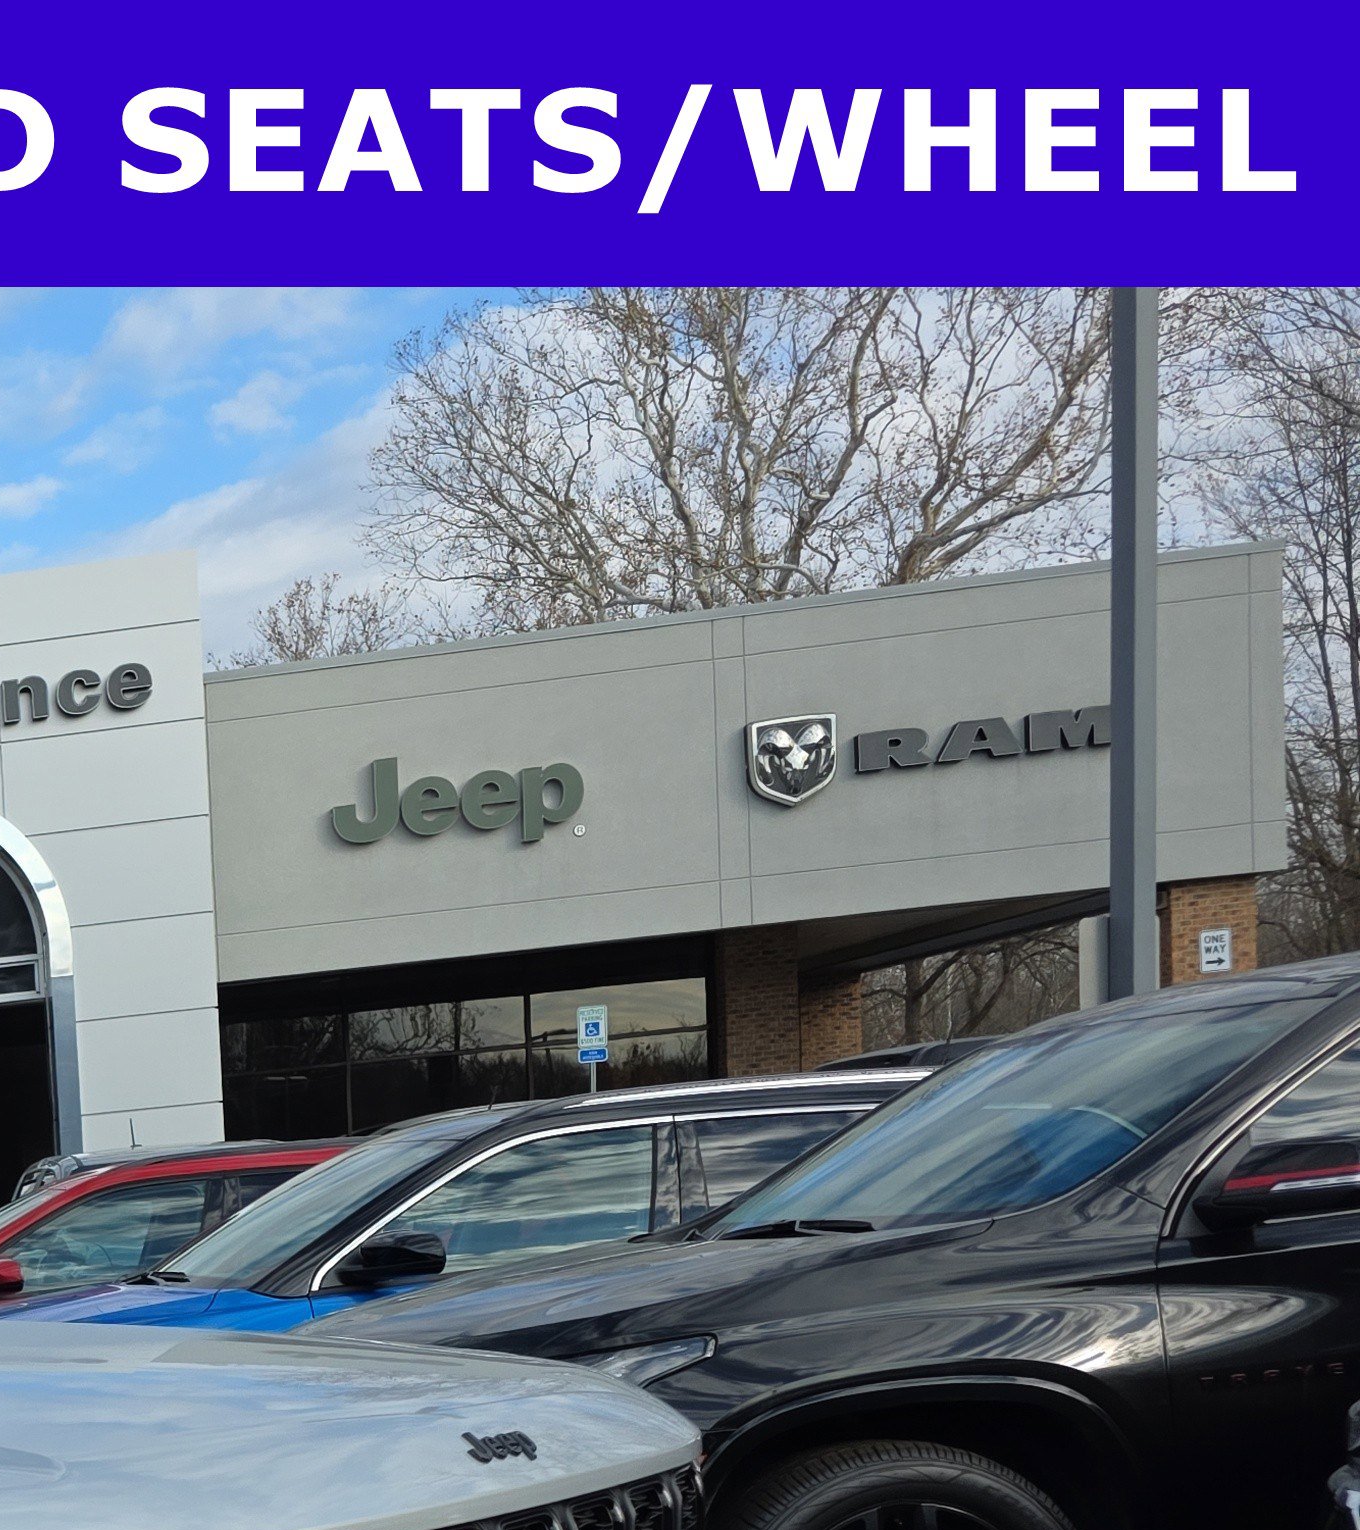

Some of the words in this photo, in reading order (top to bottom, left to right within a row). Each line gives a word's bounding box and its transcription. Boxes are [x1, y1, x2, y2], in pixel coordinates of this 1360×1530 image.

[853, 704, 1111, 775] RAM
[331, 756, 585, 844] Jeep
[1204, 934, 1226, 943] ONE
[1204, 944, 1227, 954] WAY
[461, 1431, 538, 1464] Jeep
